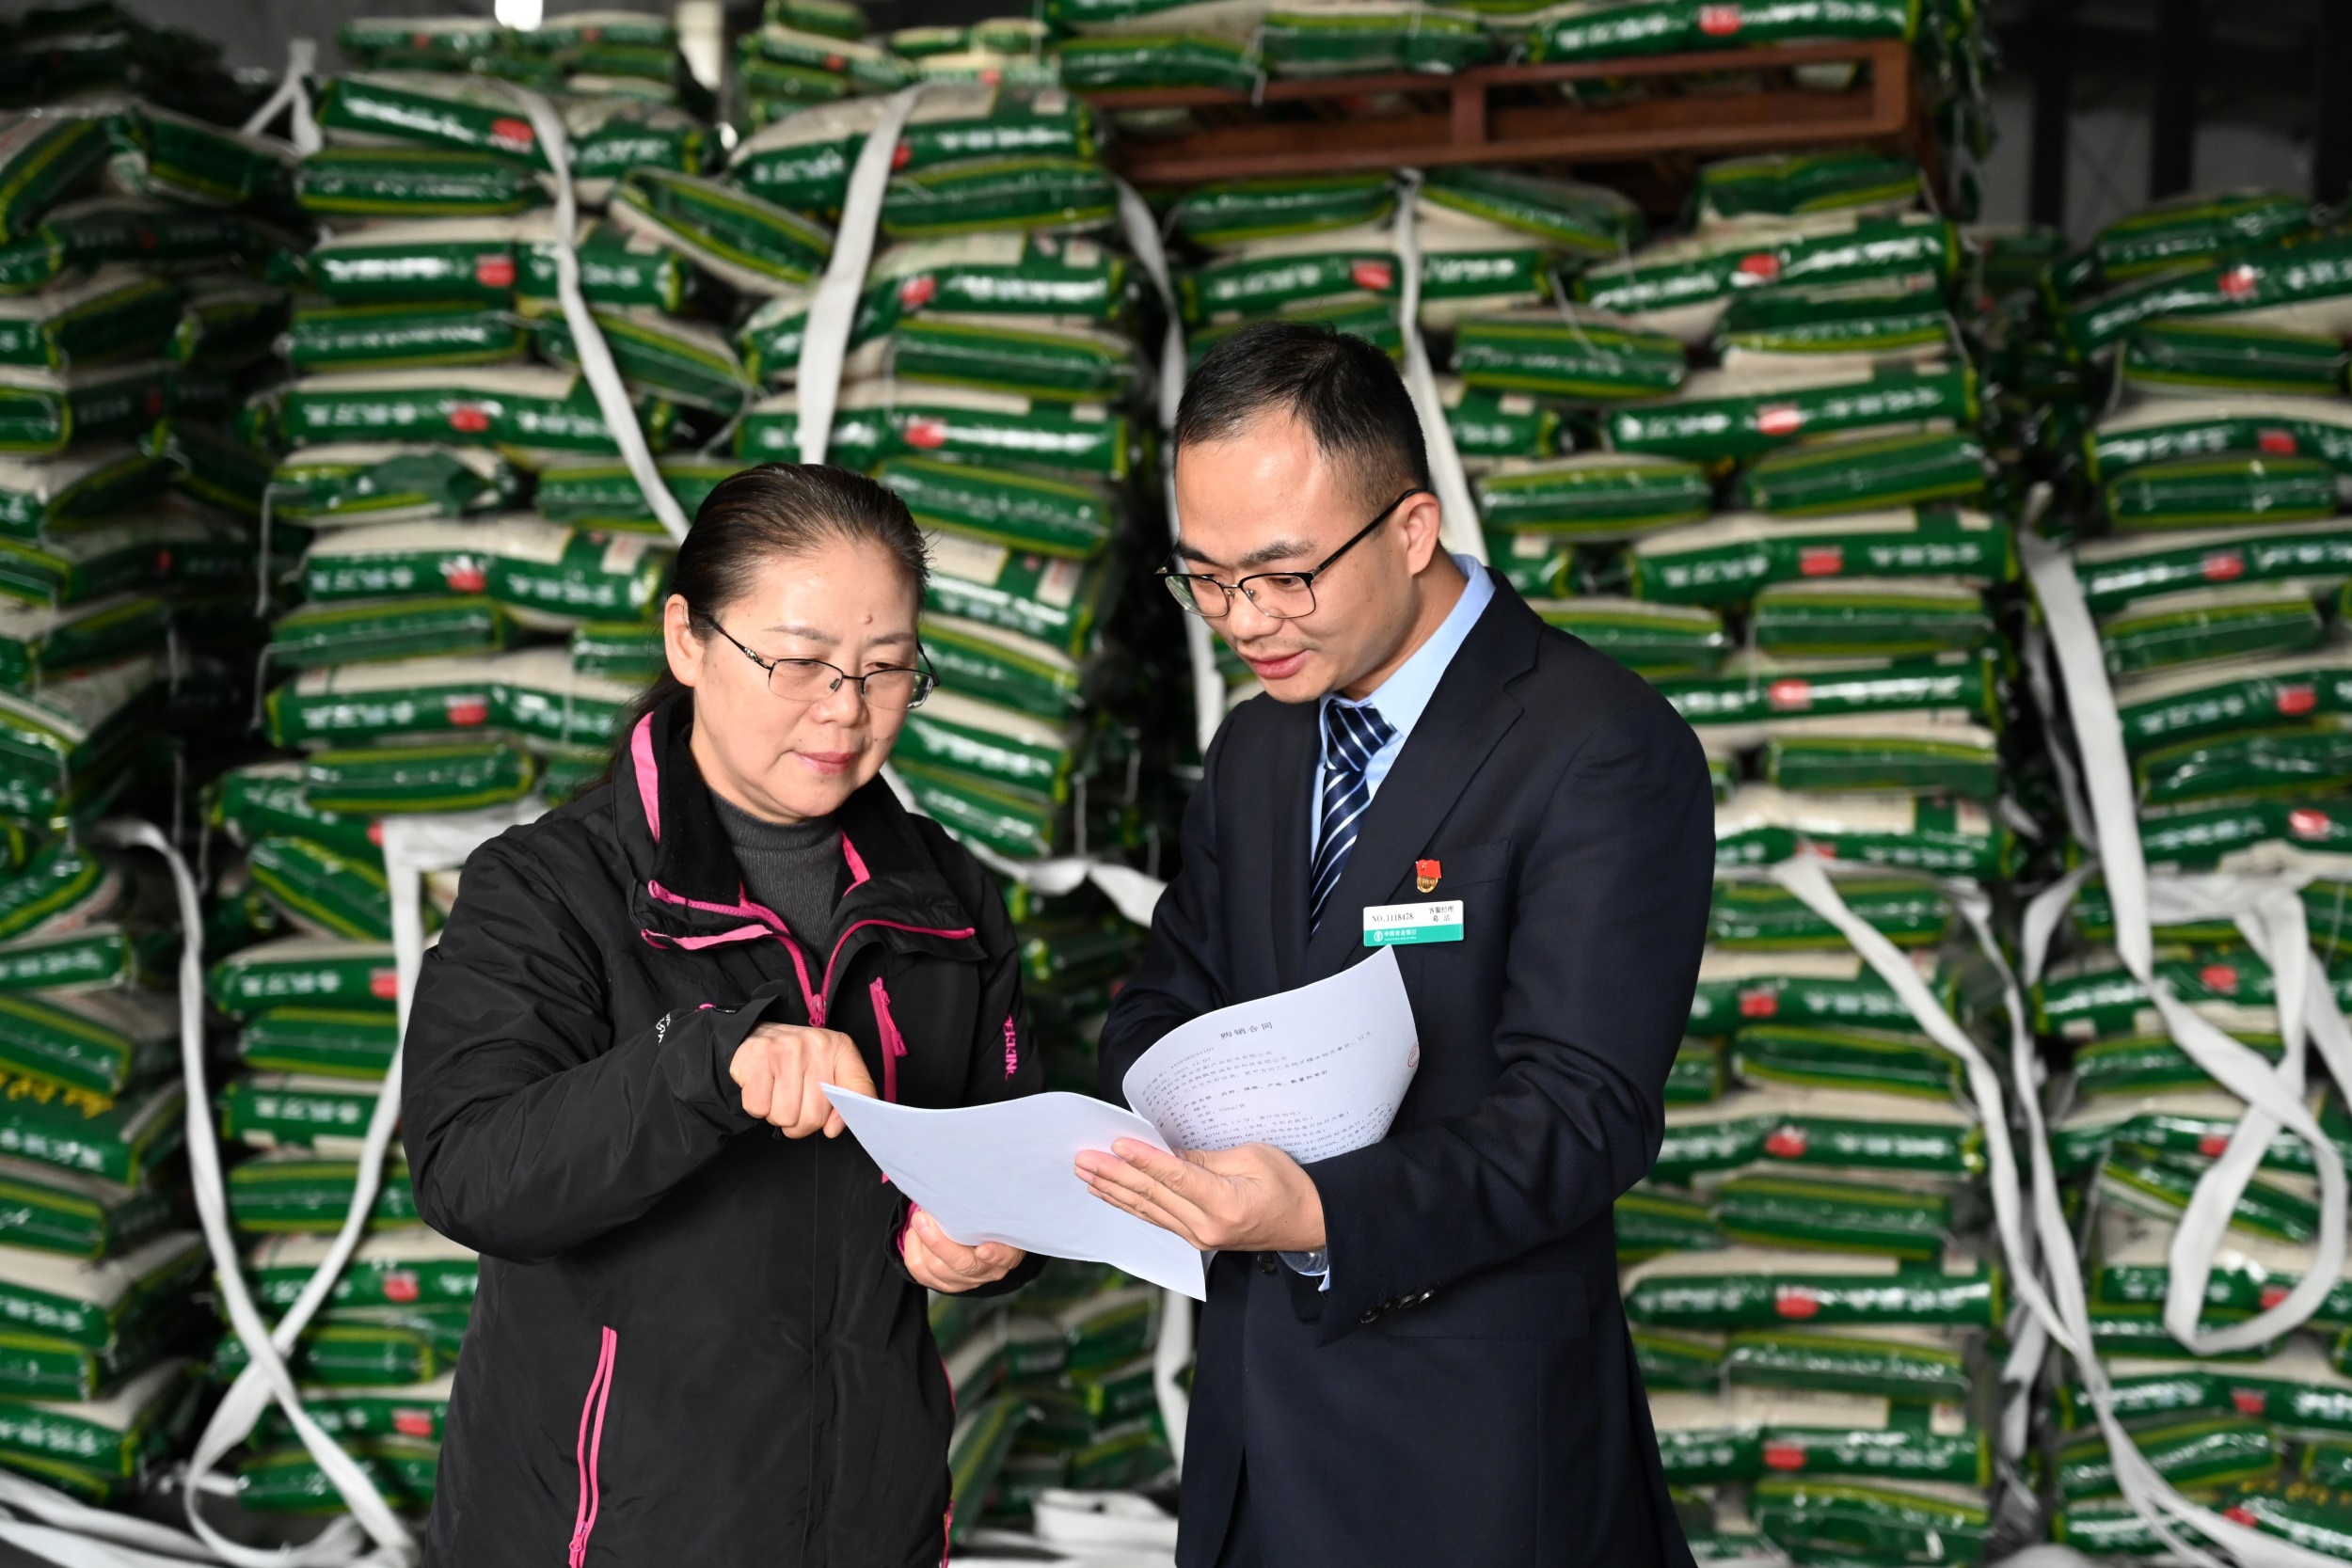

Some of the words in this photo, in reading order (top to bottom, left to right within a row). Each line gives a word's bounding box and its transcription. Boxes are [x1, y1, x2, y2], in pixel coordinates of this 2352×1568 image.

[1372, 913, 1414, 922] NO.1118478
[1384, 928, 1417, 937] 中国农业银行
[1220, 1022, 1273, 1039] 购销合同
